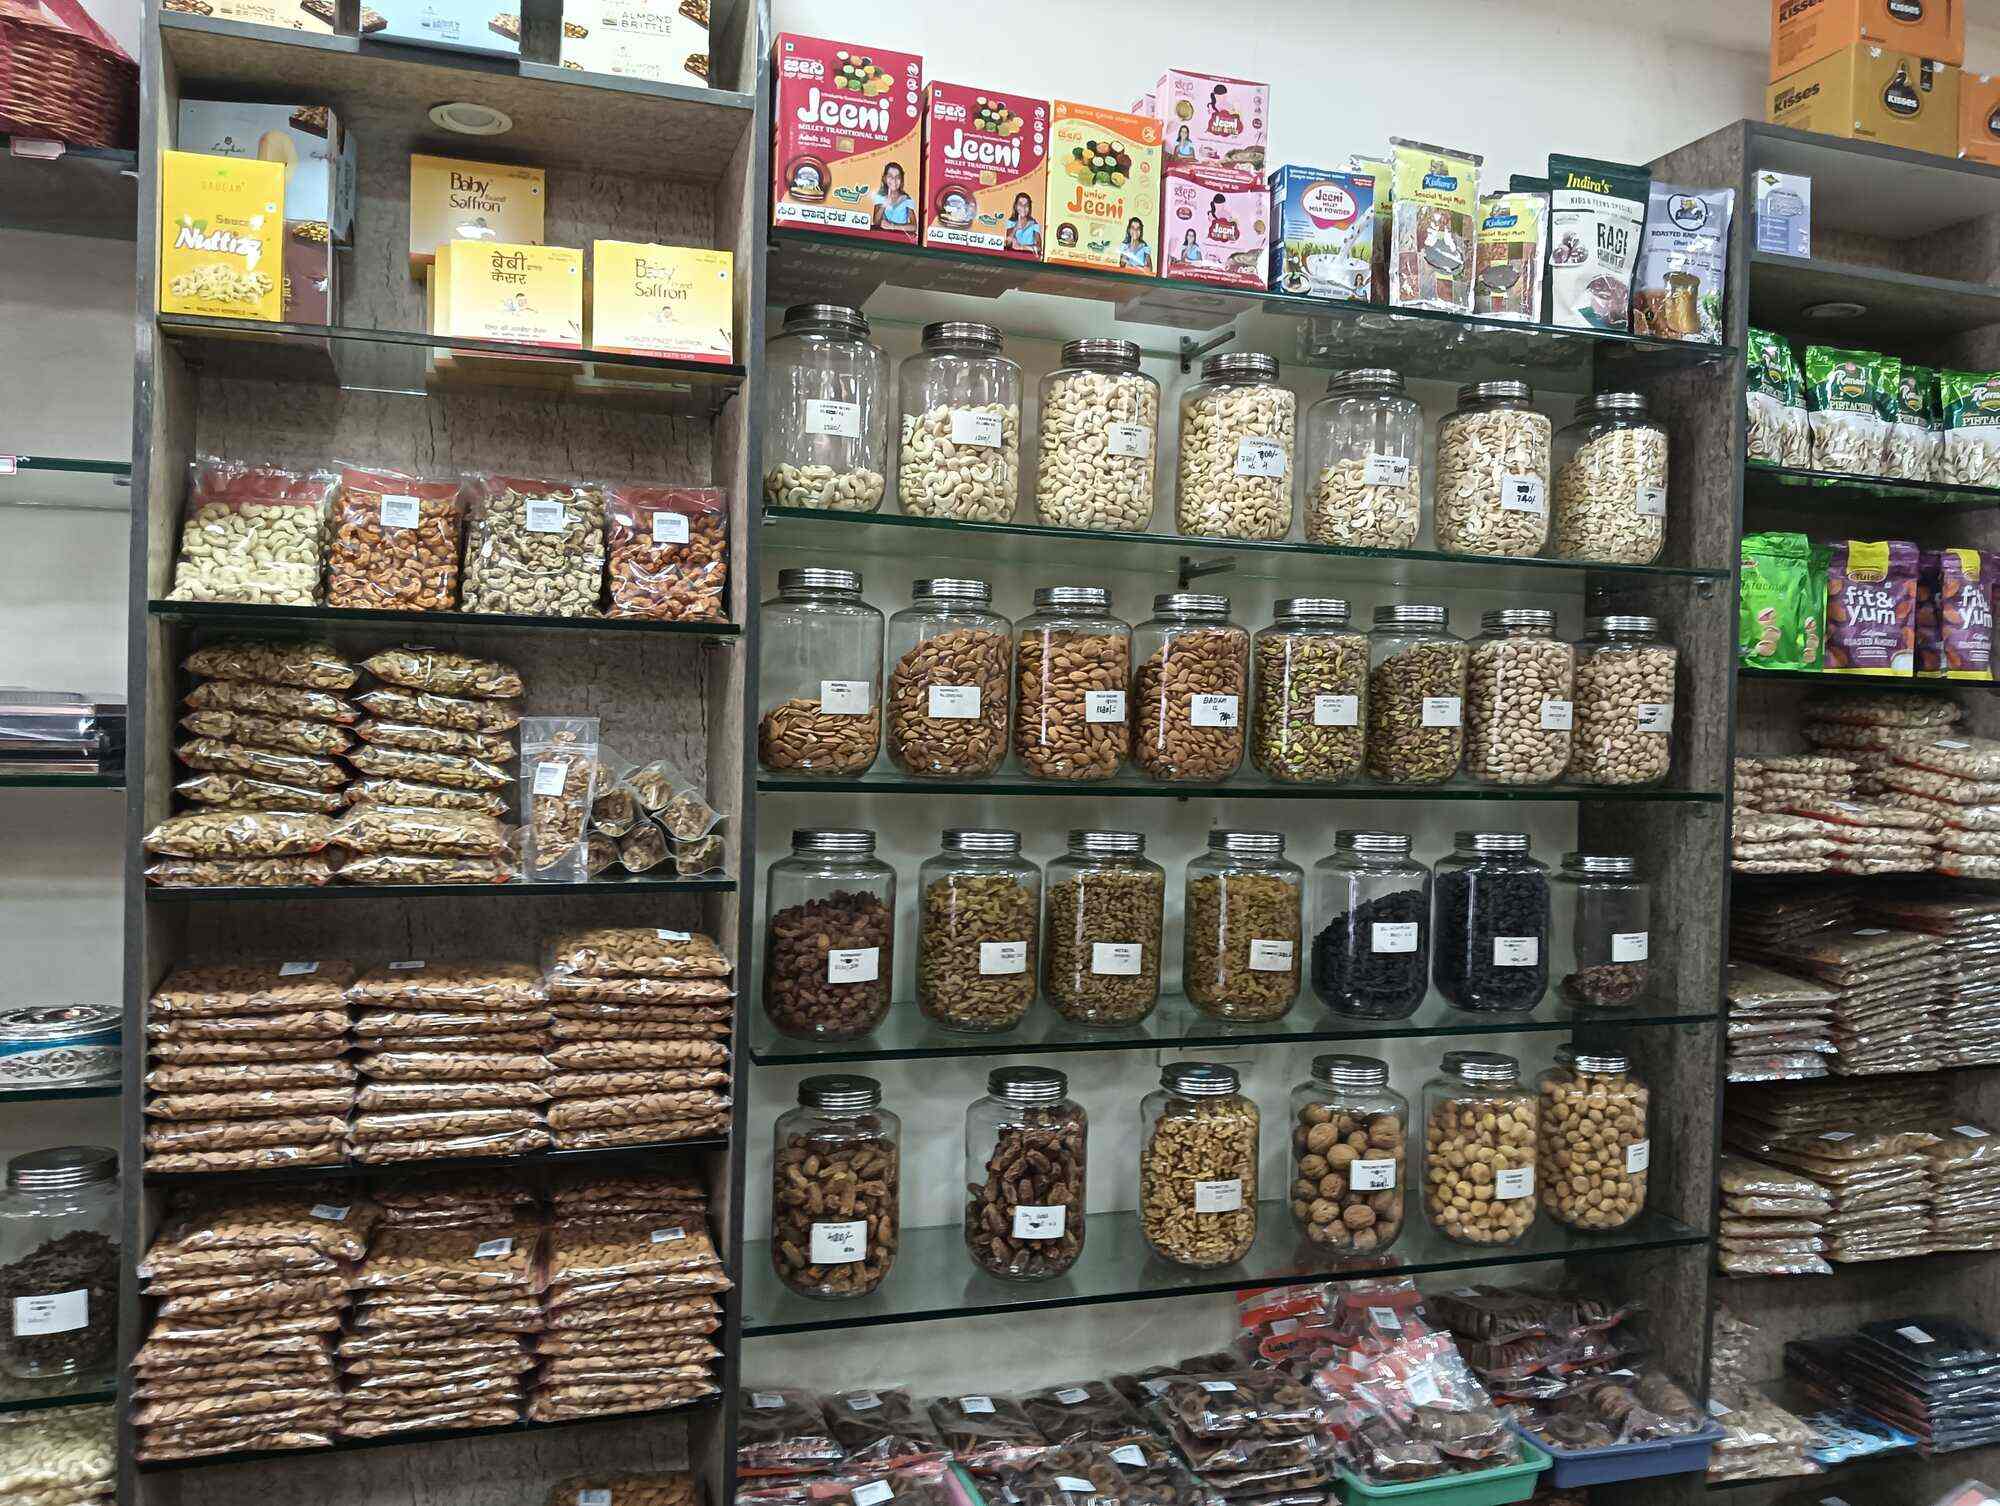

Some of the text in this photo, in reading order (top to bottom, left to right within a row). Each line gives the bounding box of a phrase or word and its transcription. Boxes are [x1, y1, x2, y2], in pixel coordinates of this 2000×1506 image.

[621, 11, 672, 24] ALMOND
[621, 20, 672, 33] BRITTLE
[797, 87, 890, 134] Jeeni
[944, 128, 1020, 168] Jeeni
[450, 172, 489, 197] Baby
[1566, 172, 1610, 193] Indira's
[449, 193, 501, 213] Saffron
[1067, 186, 1125, 219] Jeeni
[1315, 189, 1343, 203] Jeeni
[1597, 222, 1628, 255] RAGI
[491, 250, 528, 271] बेबी
[491, 268, 528, 285] केसर
[634, 281, 687, 301] Saffron
[1846, 605, 1897, 627] yum
